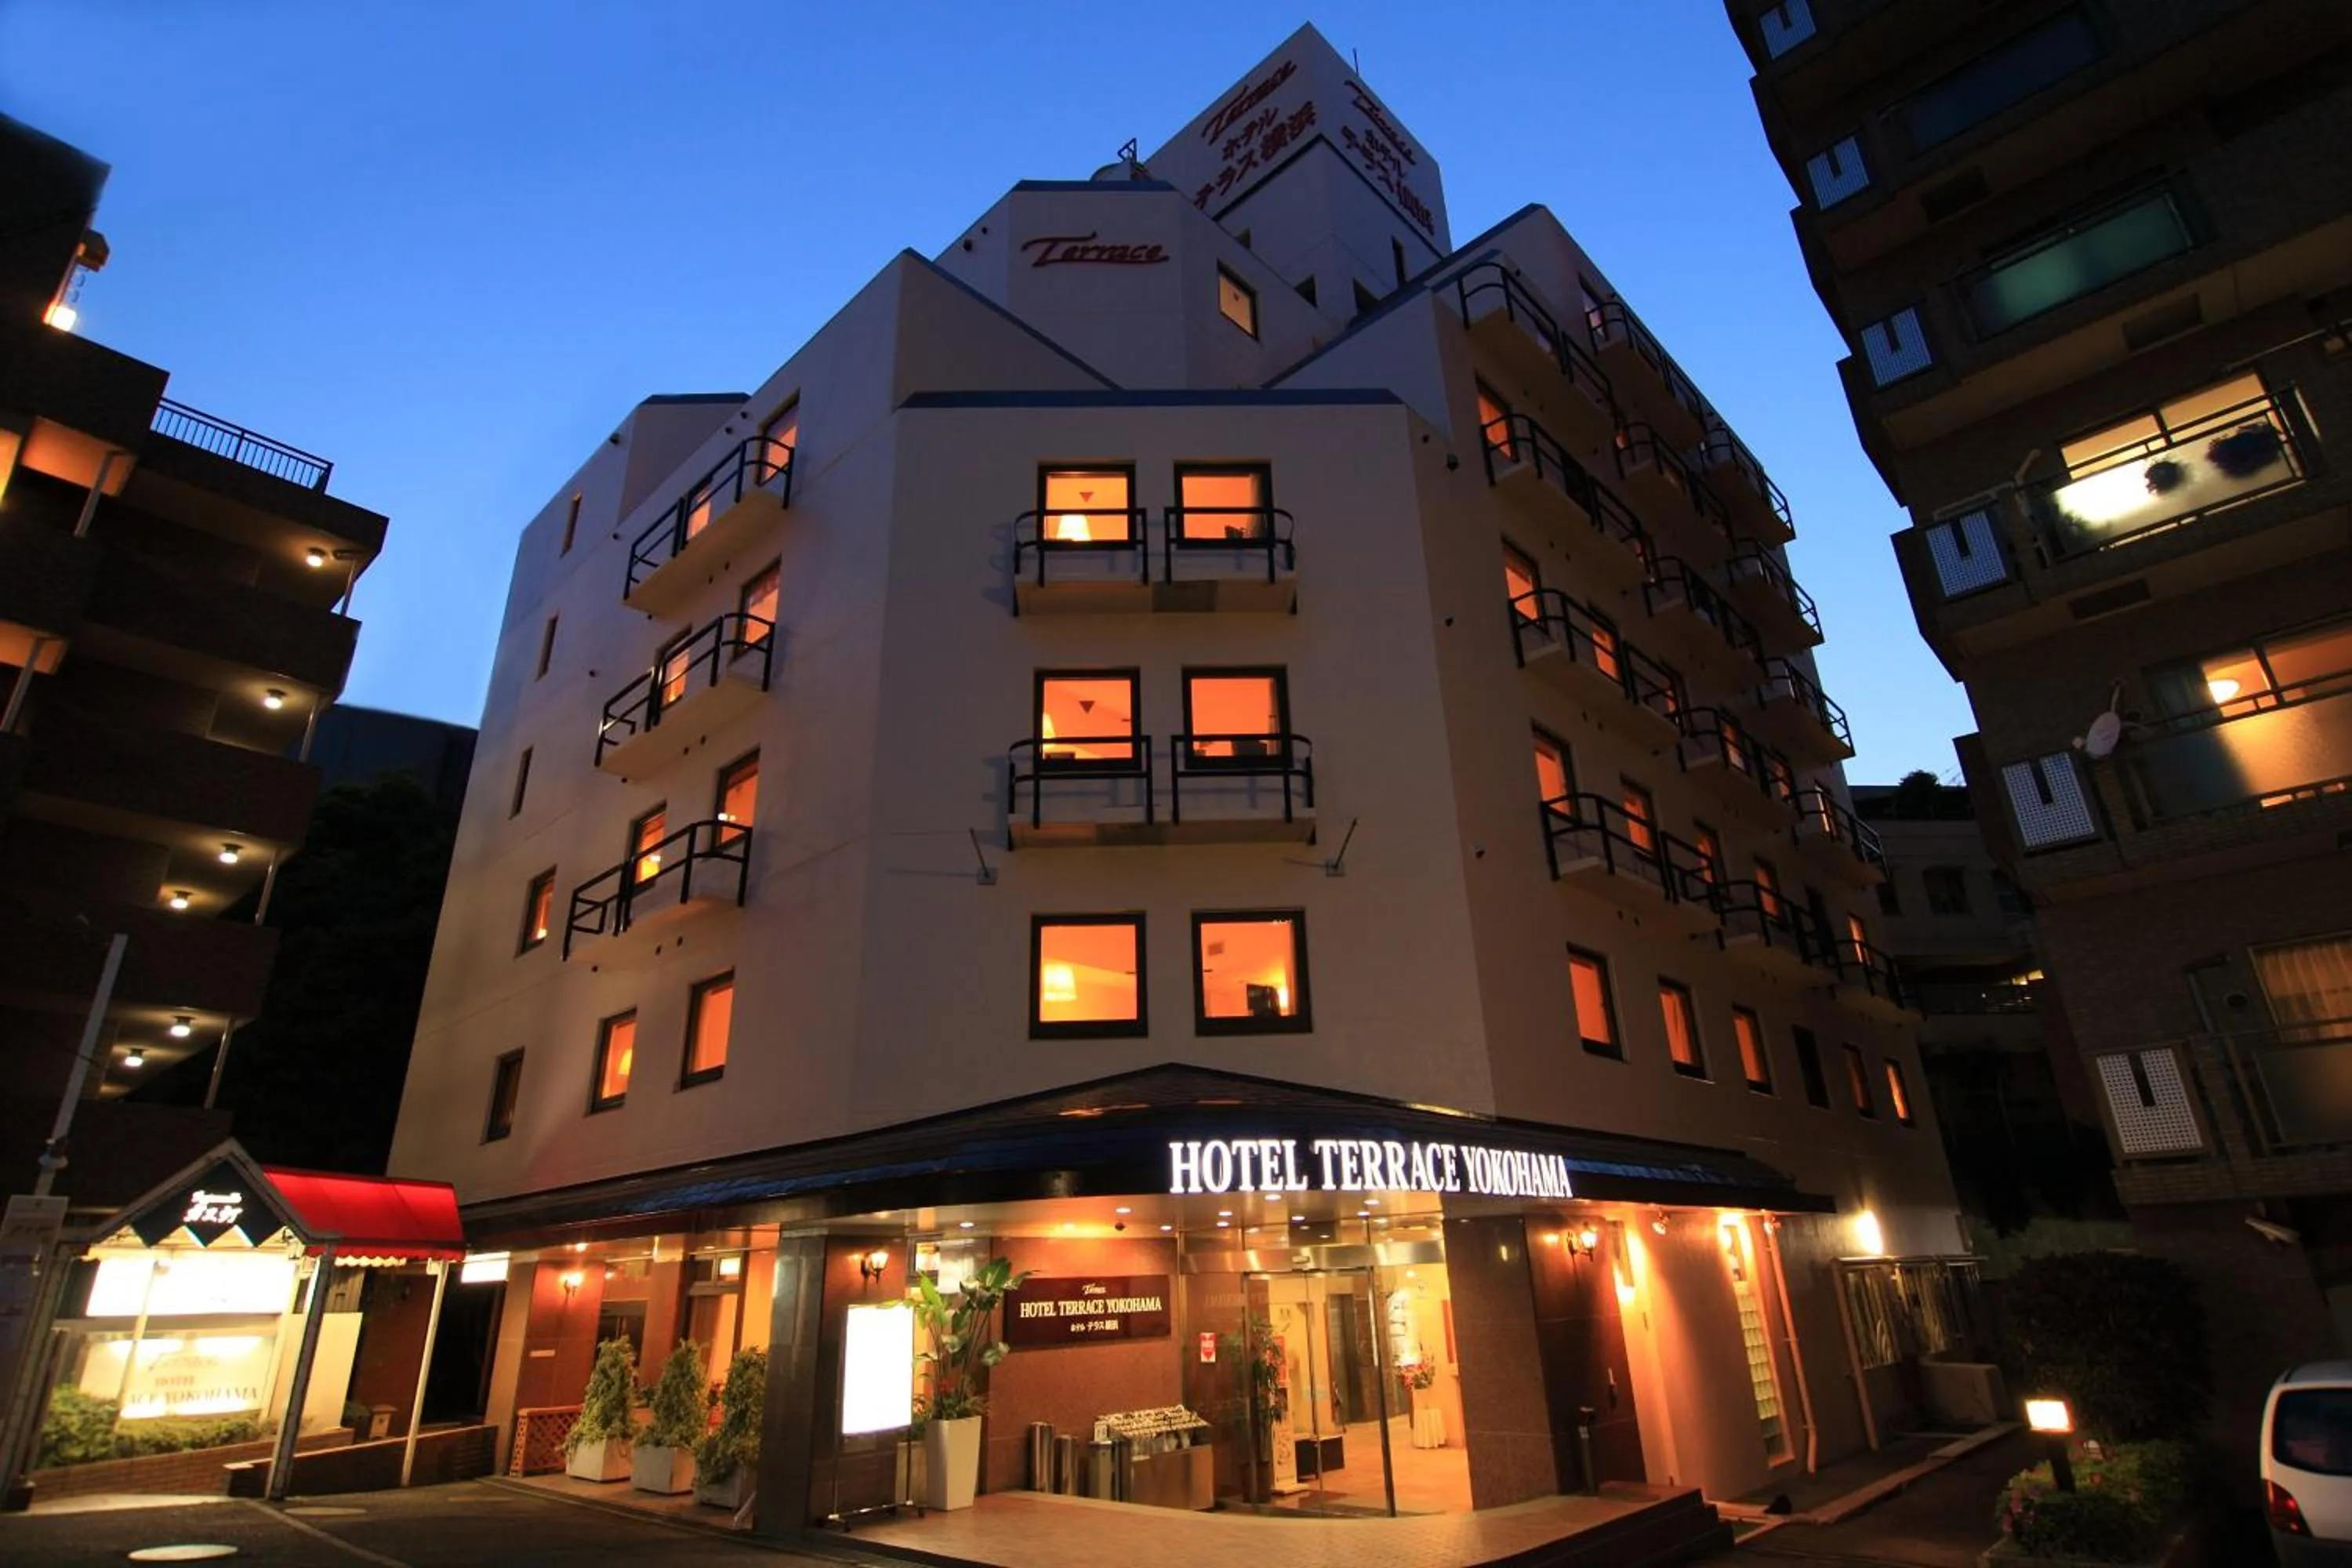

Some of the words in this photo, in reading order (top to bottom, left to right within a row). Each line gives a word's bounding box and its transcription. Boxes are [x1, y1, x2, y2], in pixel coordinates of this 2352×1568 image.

[1021, 230, 1170, 268] Terrace
[1169, 1139, 1308, 1193] HOTEL
[1313, 1139, 1461, 1193] TERRACE
[1461, 1145, 1573, 1200] YOKOHAMA
[1020, 1301, 1057, 1318] HOTEL
[1058, 1298, 1105, 1316] TERRACE
[1105, 1296, 1163, 1313] YOKOHAMA
